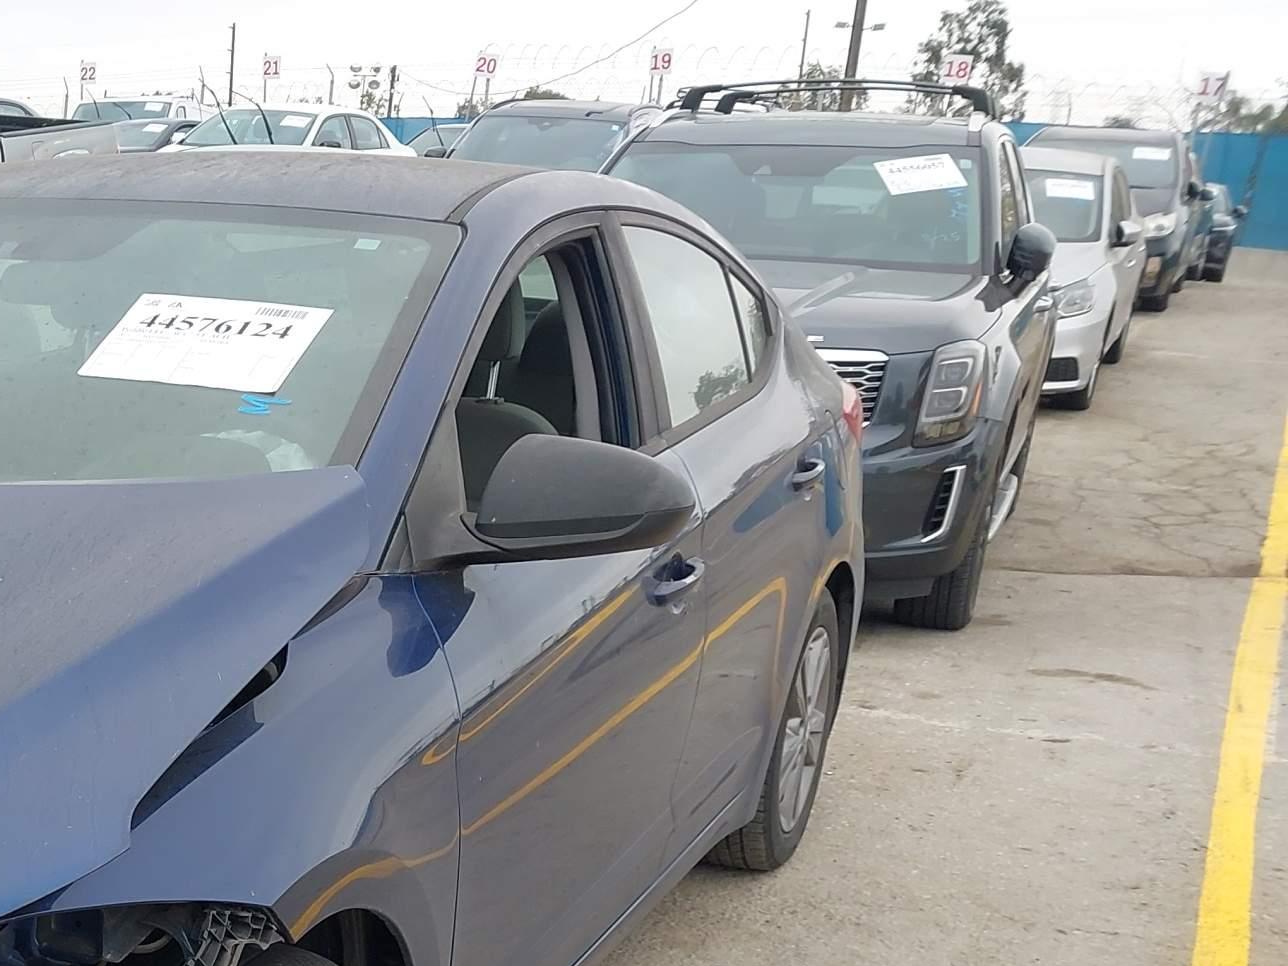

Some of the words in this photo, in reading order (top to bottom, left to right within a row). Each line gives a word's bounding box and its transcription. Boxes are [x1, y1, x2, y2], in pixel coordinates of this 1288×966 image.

[263, 59, 280, 76] 21
[475, 56, 498, 75] 20
[650, 53, 672, 70] 19
[943, 60, 969, 78] 18
[80, 66, 96, 81] 22
[1196, 76, 1225, 97] 17
[139, 313, 294, 339] 44576124
